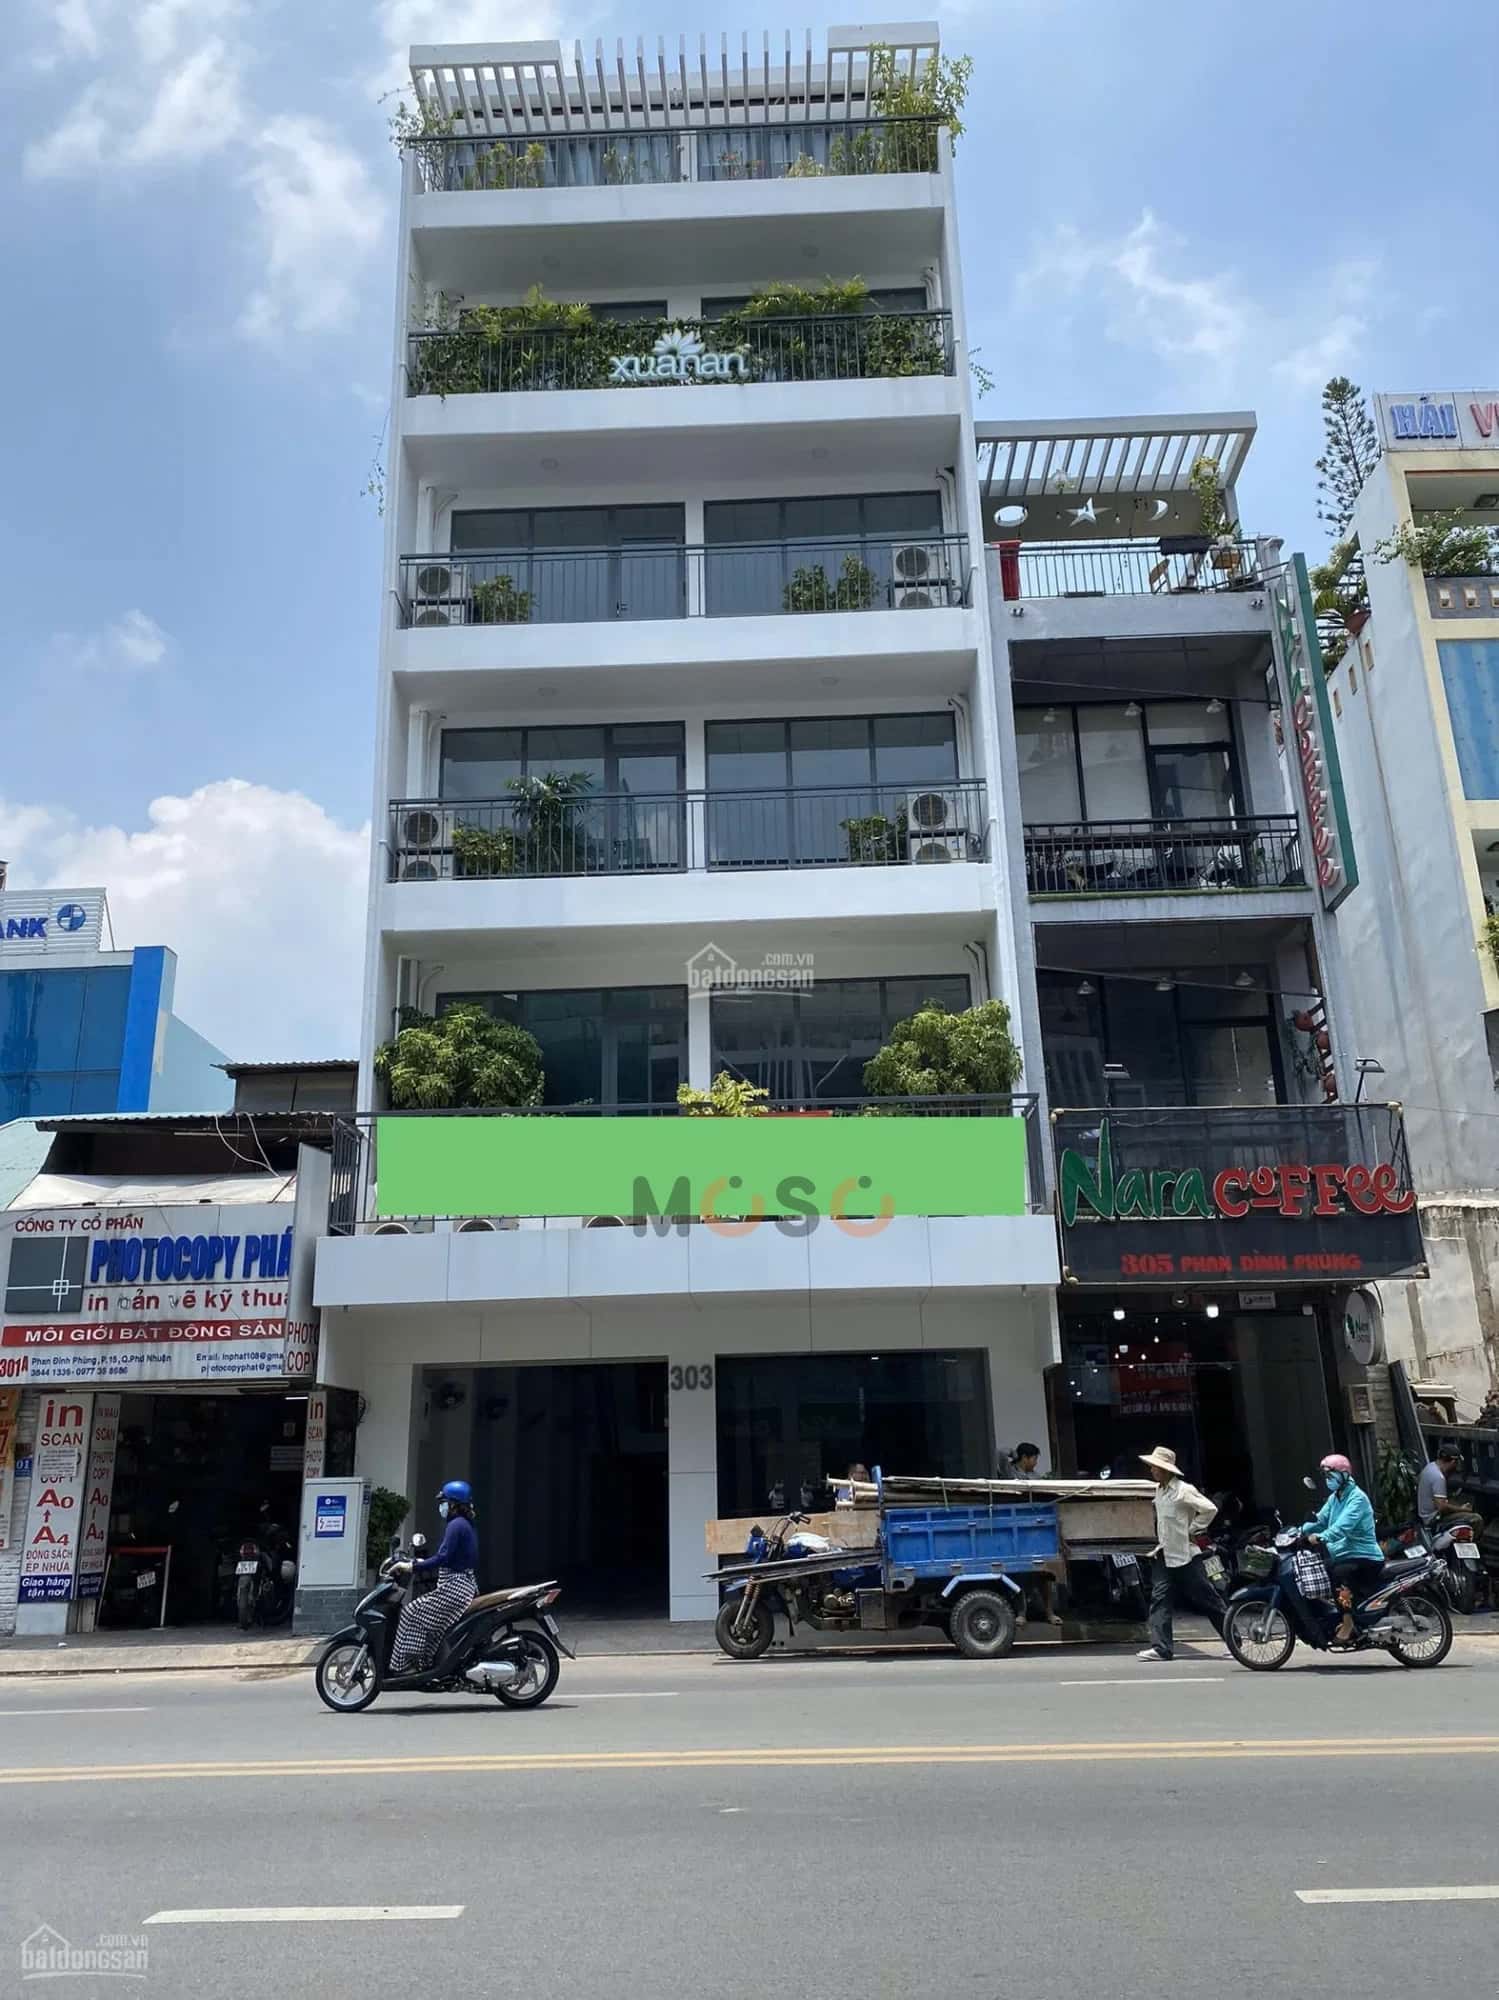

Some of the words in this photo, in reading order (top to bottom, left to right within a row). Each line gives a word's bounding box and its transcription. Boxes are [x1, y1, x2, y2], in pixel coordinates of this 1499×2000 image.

[608, 352, 750, 381] xuanan
[1060, 1118, 1213, 1226] Nara
[15, 1217, 54, 1232] CÔNG
[59, 1219, 77, 1231] TY
[90, 1237, 240, 1283] PHOTOCOPY
[1120, 1254, 1174, 1275] 305
[1180, 1255, 1232, 1273] PHAN
[88, 1292, 109, 1311] in
[204, 1288, 233, 1312] kỹ
[25, 1326, 63, 1342] MÔI
[70, 1324, 113, 1341] GIỚI
[168, 1322, 232, 1340] ĐỘNG
[239, 1320, 282, 1336] SẢN
[671, 1365, 712, 1391] 303
[45, 1400, 83, 1427] in
[41, 1432, 83, 1446] SCAN
[36, 1488, 74, 1508] A0
[32, 1526, 69, 1545] A4
[22, 1577, 44, 1587] Giao
